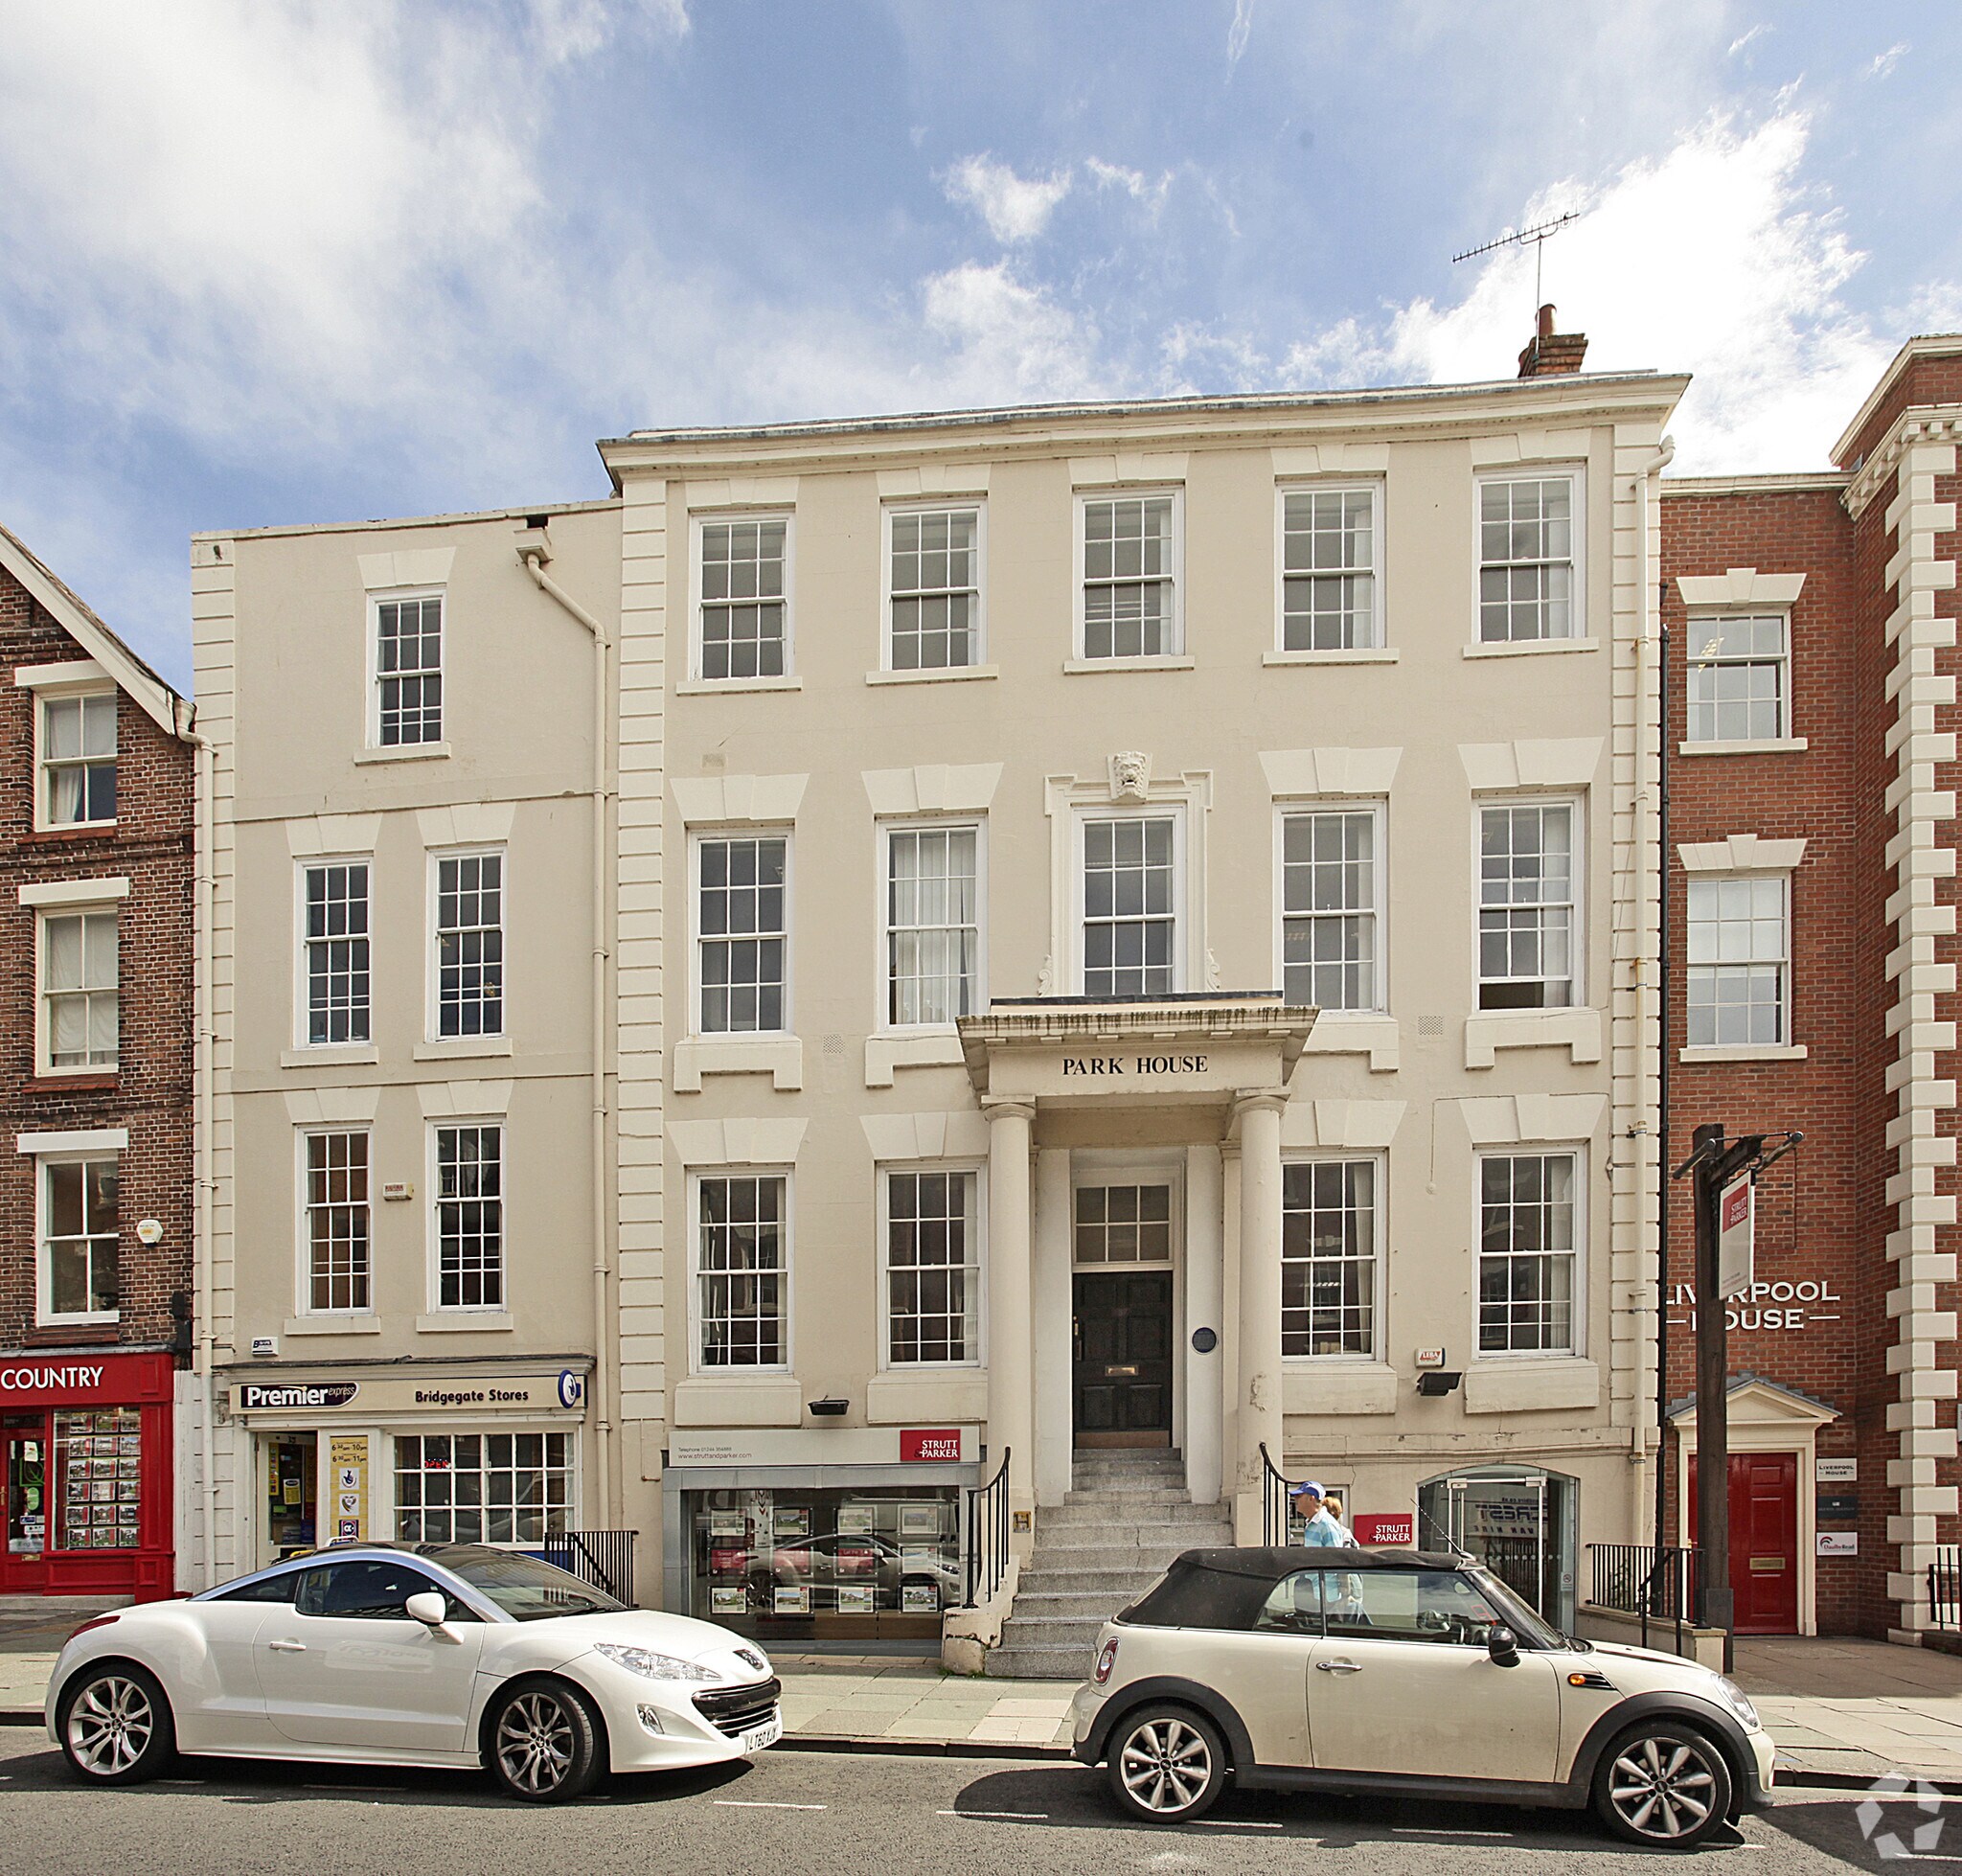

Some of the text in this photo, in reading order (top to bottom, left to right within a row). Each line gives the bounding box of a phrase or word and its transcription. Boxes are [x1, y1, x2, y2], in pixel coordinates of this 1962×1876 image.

[1062, 1055, 1208, 1075] PARK HOUSE
[1691, 1308, 1804, 1331] OUSE
[1, 1366, 103, 1389] COUNTRY
[247, 1385, 354, 1406] Premier express
[415, 1389, 528, 1405] Bridgegate Stores
[922, 1440, 957, 1449] STRUTT
[920, 1449, 958, 1457] PARKER
[1375, 1524, 1410, 1534] STRUTT
[1373, 1533, 1411, 1543] PARKER
